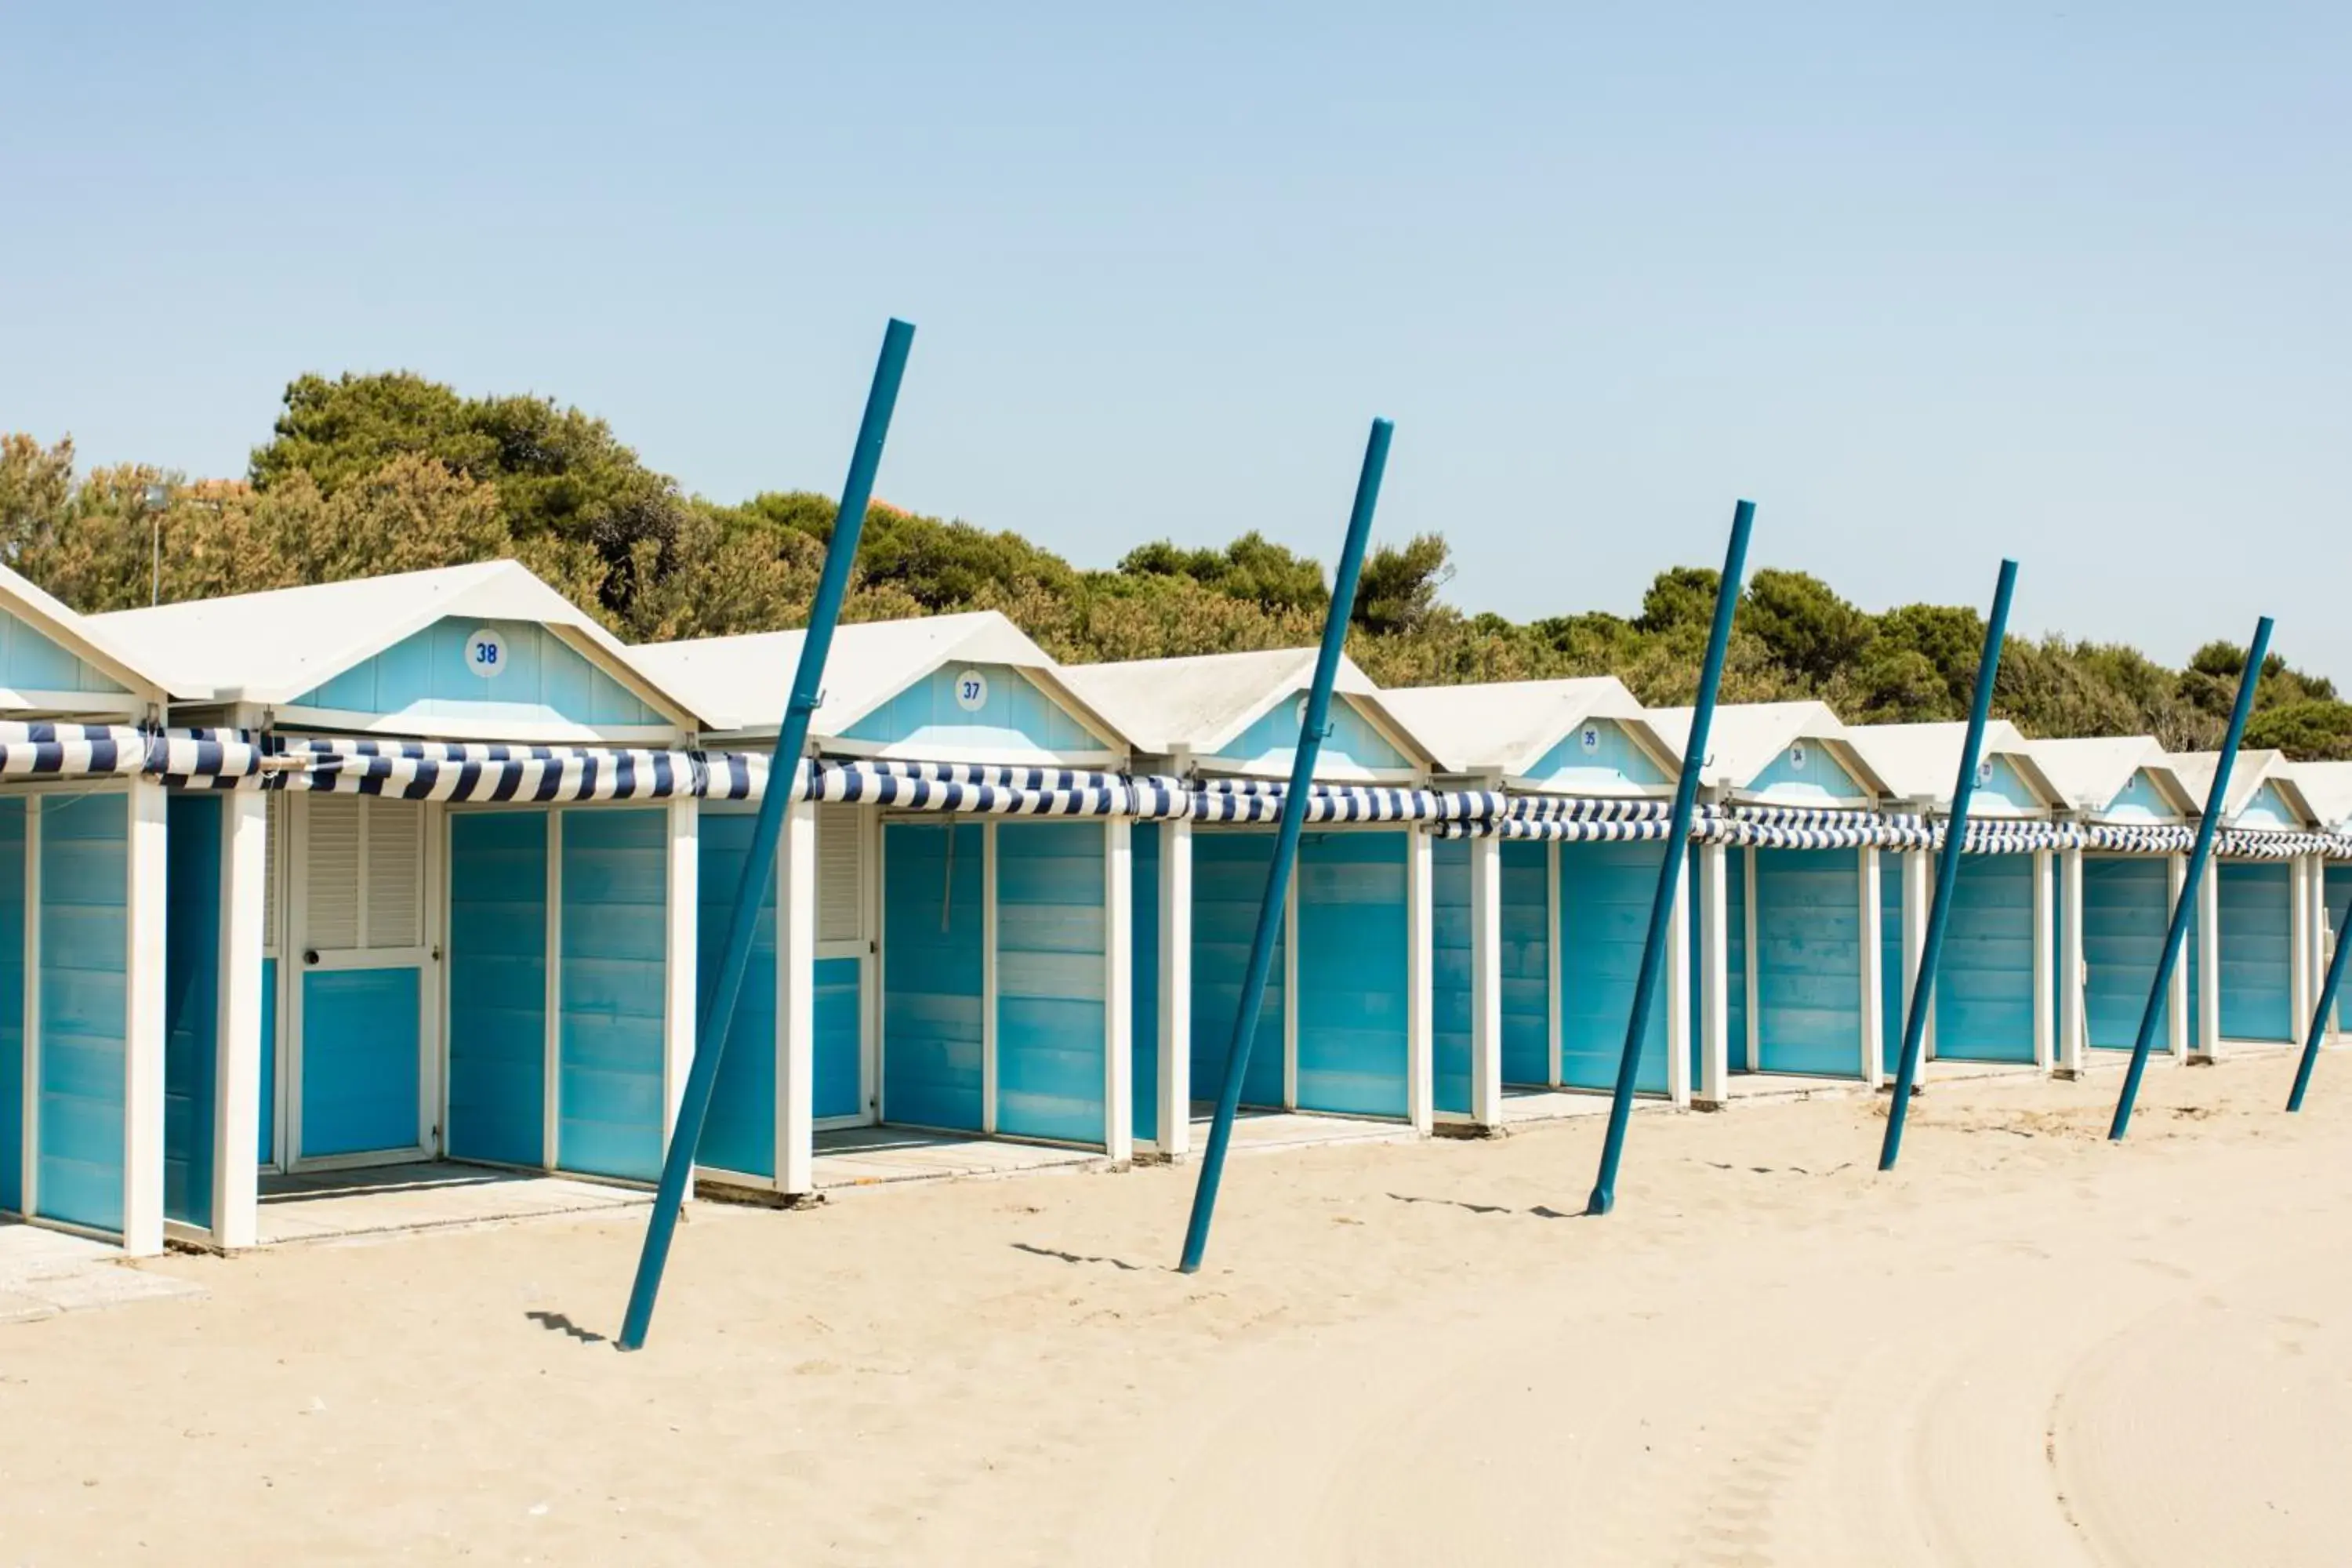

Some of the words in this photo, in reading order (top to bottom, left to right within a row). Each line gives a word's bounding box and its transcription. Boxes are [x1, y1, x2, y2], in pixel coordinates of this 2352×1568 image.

[476, 642, 497, 664] 38
[964, 681, 979, 699] 37
[1584, 731, 1595, 746] 35
